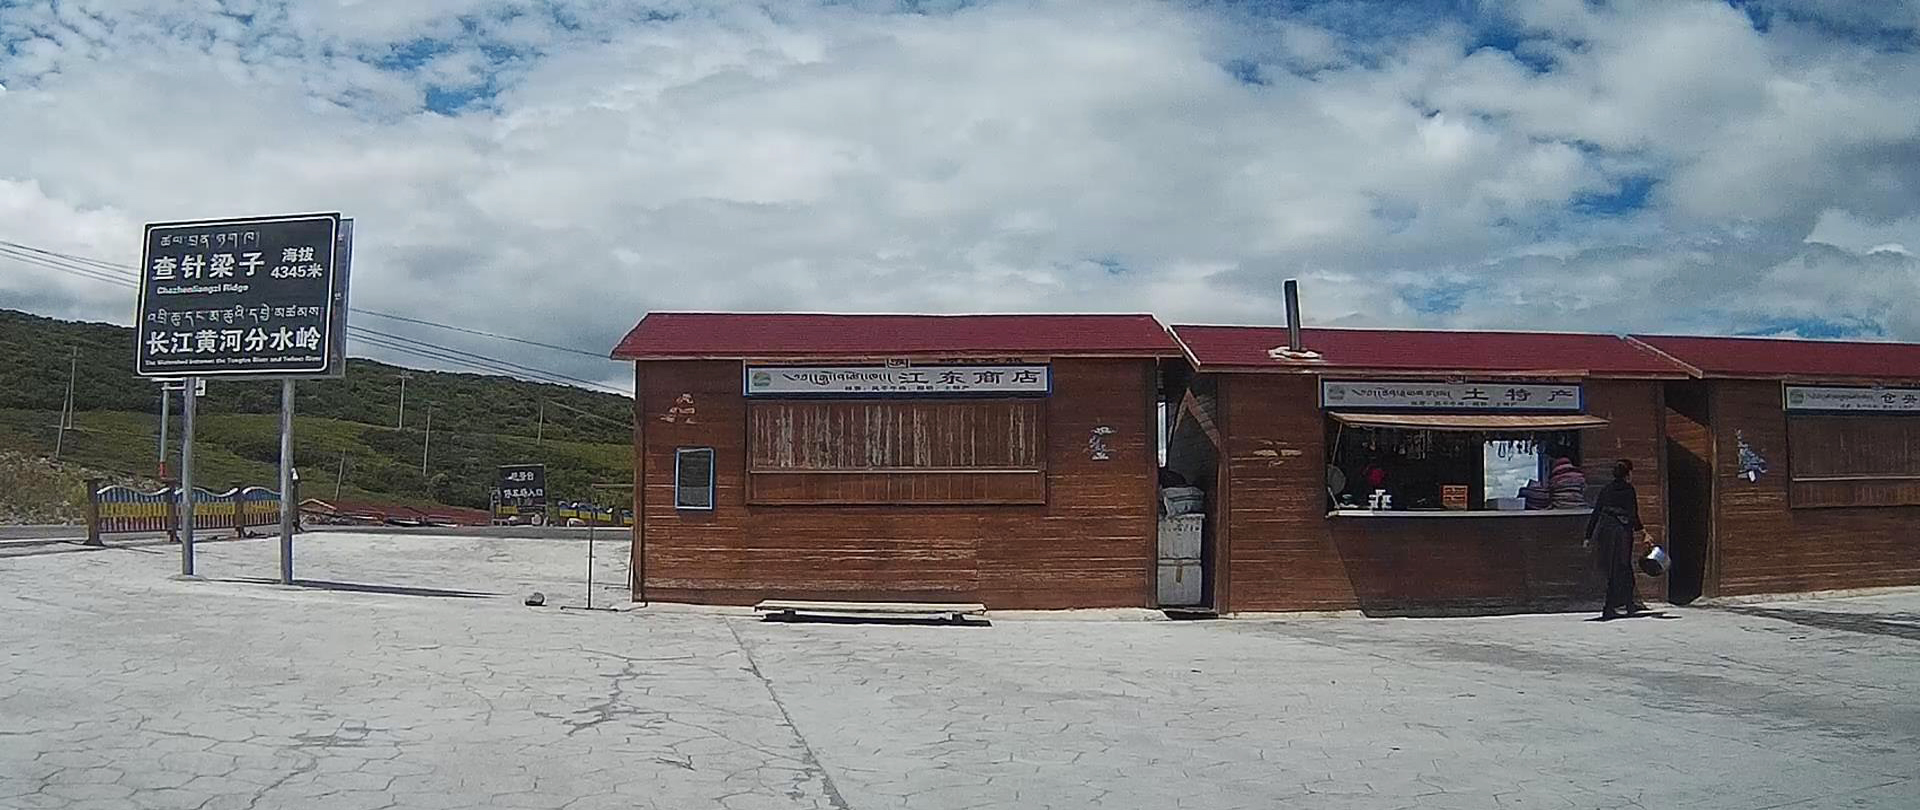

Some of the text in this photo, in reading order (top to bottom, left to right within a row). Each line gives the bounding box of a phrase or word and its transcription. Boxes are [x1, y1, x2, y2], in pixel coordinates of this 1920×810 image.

[282, 247, 314, 262] 海拔
[152, 252, 265, 281] 查针梁子
[270, 263, 323, 280] 4345米
[223, 284, 249, 293] Ridge
[145, 326, 321, 355] 长江黄河分水岭
[898, 371, 1041, 385] 江东商店
[1461, 387, 1574, 402] 土特产
